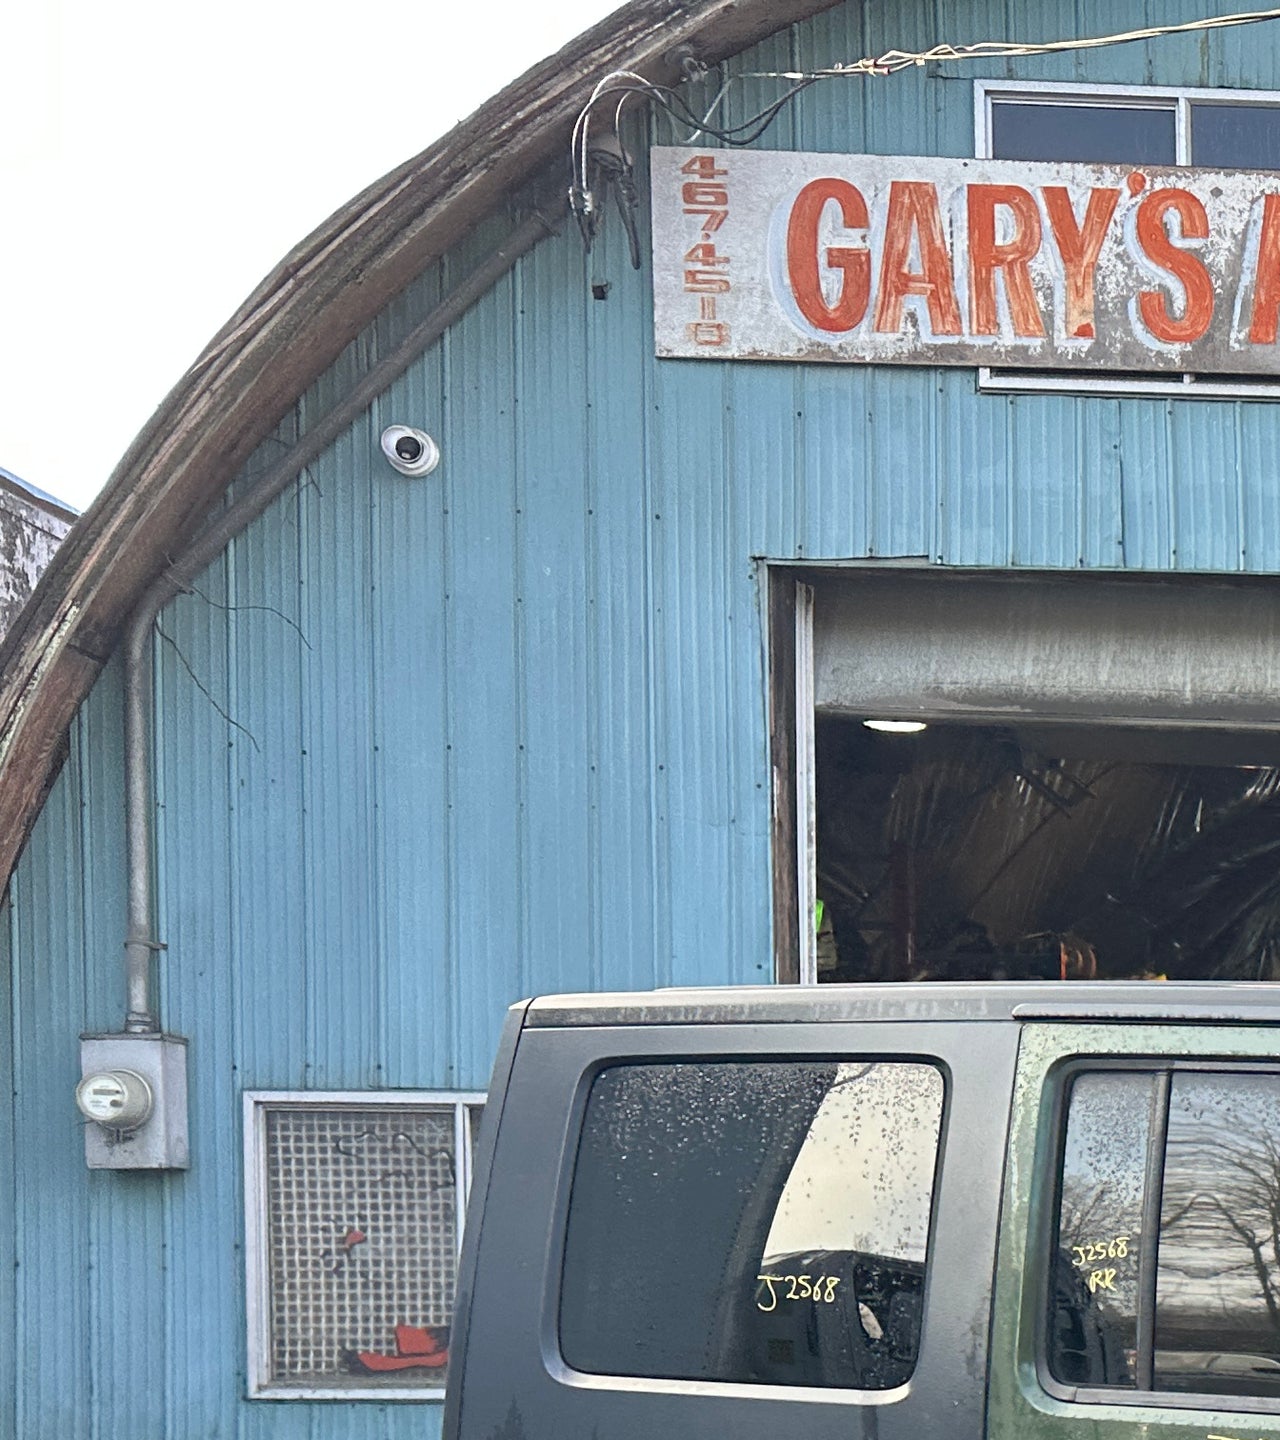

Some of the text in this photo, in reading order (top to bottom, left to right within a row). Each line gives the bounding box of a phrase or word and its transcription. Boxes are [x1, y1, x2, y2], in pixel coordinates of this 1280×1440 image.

[784, 171, 1212, 344] GARY'S
[1071, 1236, 1130, 1267] J2568
[756, 1274, 840, 1311] J2568
[1089, 1268, 1117, 1293] RR
